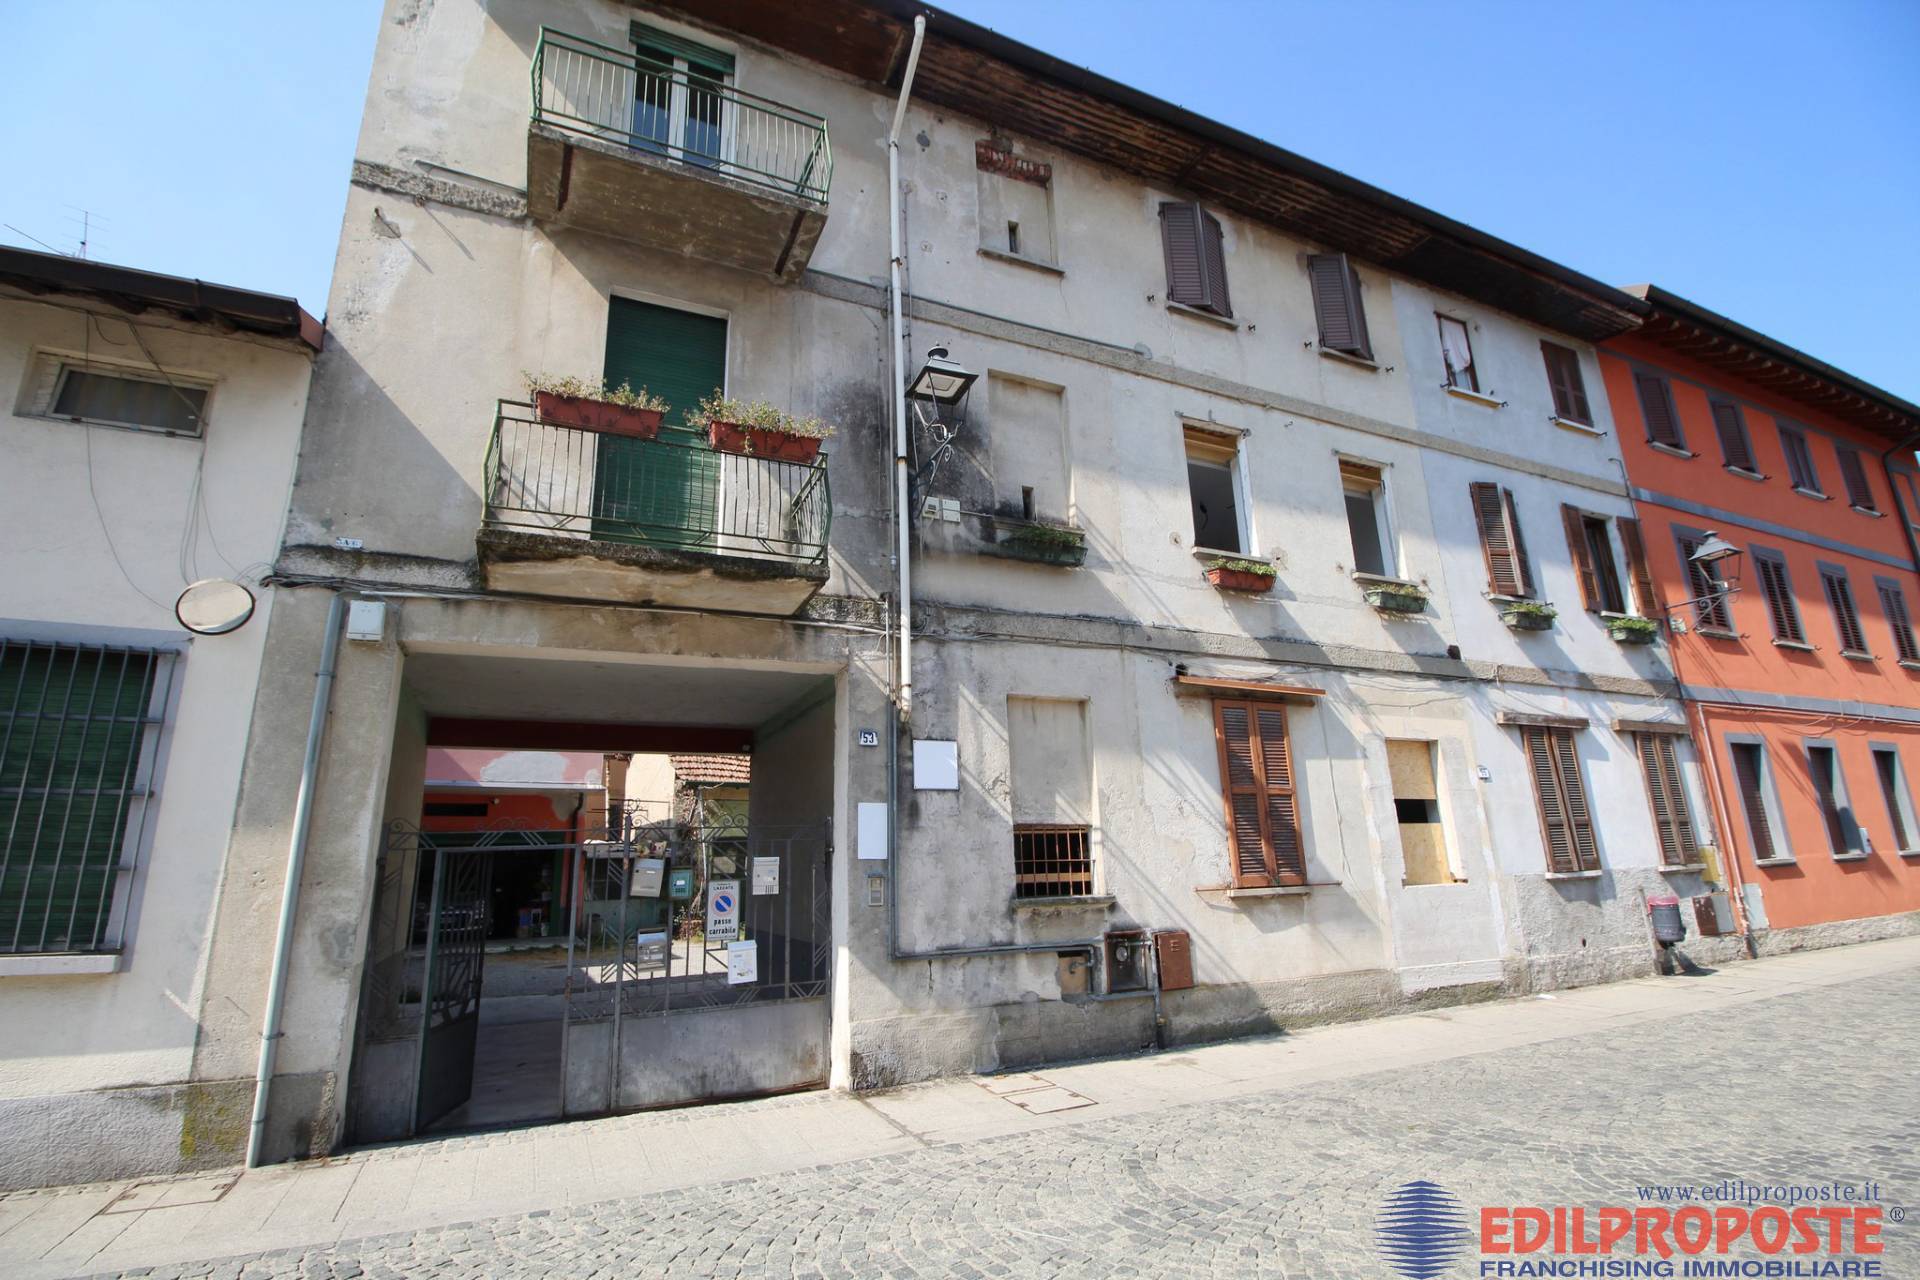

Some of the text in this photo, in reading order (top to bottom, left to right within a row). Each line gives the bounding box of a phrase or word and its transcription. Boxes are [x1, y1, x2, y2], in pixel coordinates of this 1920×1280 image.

[863, 732, 874, 744] 53
[713, 918, 732, 926] passo
[709, 927, 737, 935] carrabile
